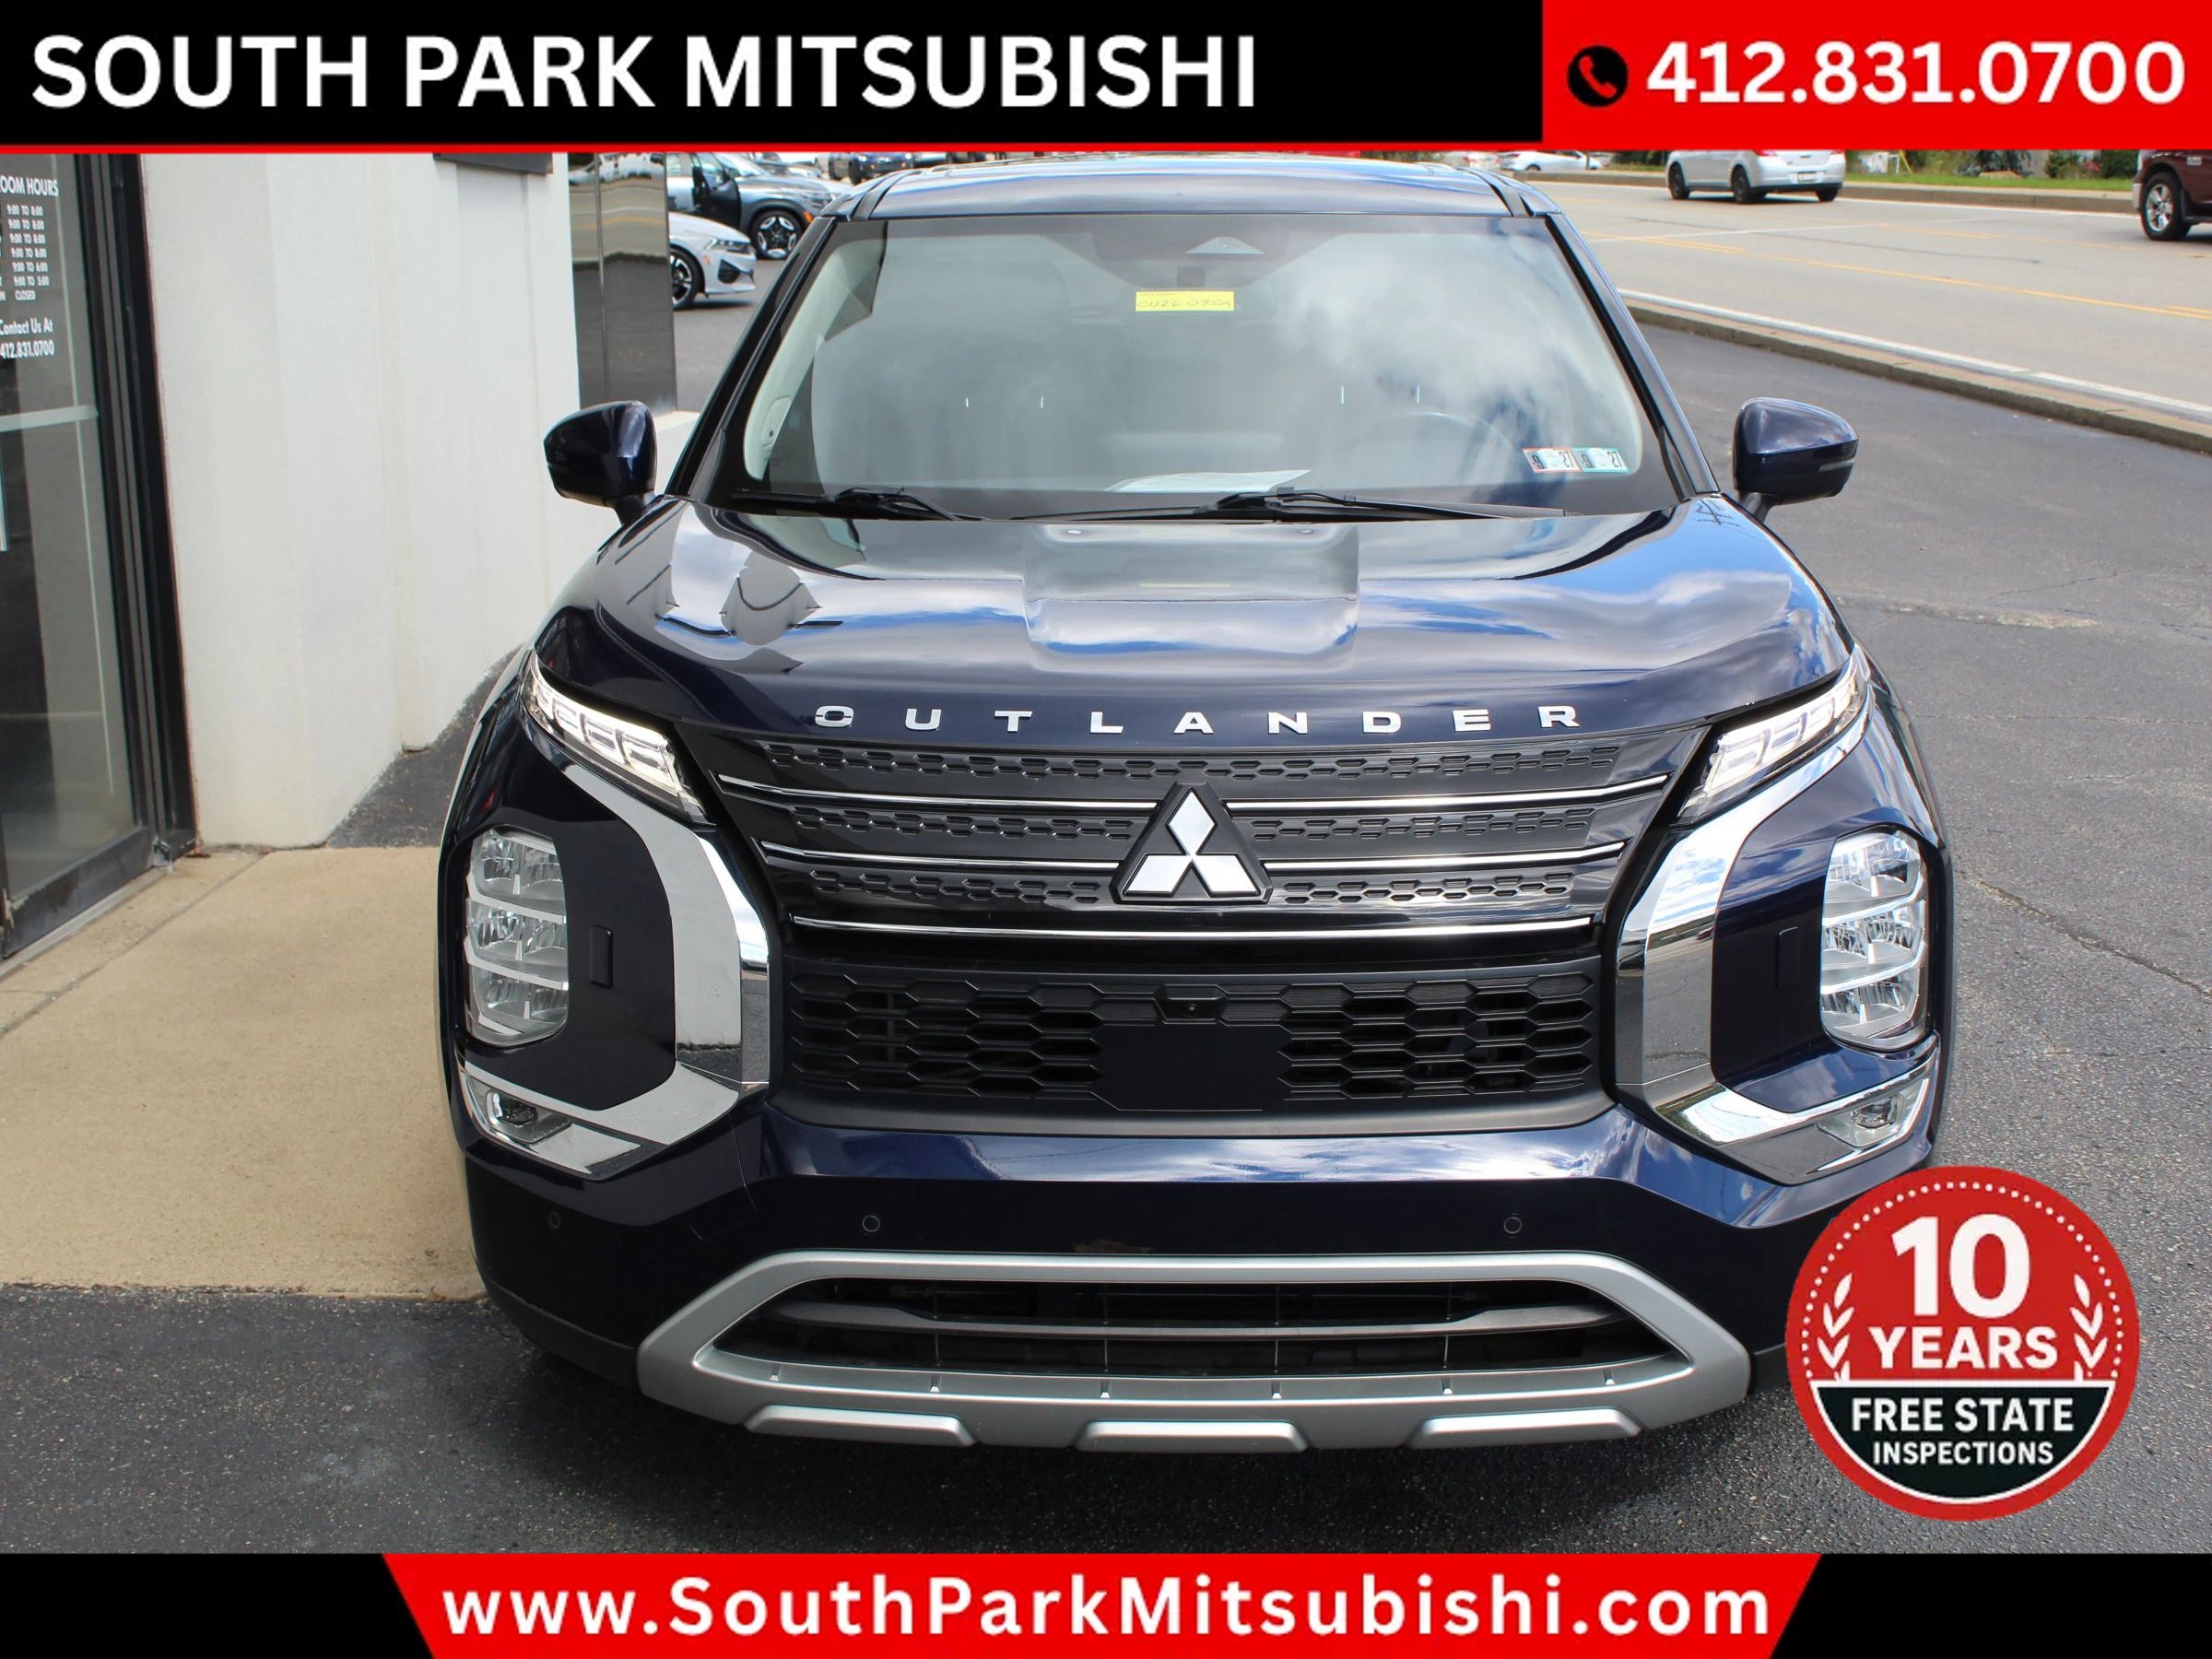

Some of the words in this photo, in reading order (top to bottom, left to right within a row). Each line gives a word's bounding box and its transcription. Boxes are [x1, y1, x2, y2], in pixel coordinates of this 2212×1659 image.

[0, 175, 25, 194] OOM
[26, 177, 59, 196] HOURS
[20, 205, 29, 216] TO
[21, 219, 30, 230] TO
[23, 233, 32, 244] TO
[25, 247, 33, 258] TO
[26, 262, 34, 273] TO
[27, 276, 35, 287] TO
[15, 289, 36, 301] CLOSED
[0, 318, 29, 335] Contact
[30, 317, 41, 334] Us
[43, 317, 53, 333] At
[0, 339, 55, 359] 412.831.0700
[1559, 451, 1575, 468] 27
[1606, 451, 1624, 468] 27
[815, 704, 1581, 735] OUTLANDER
